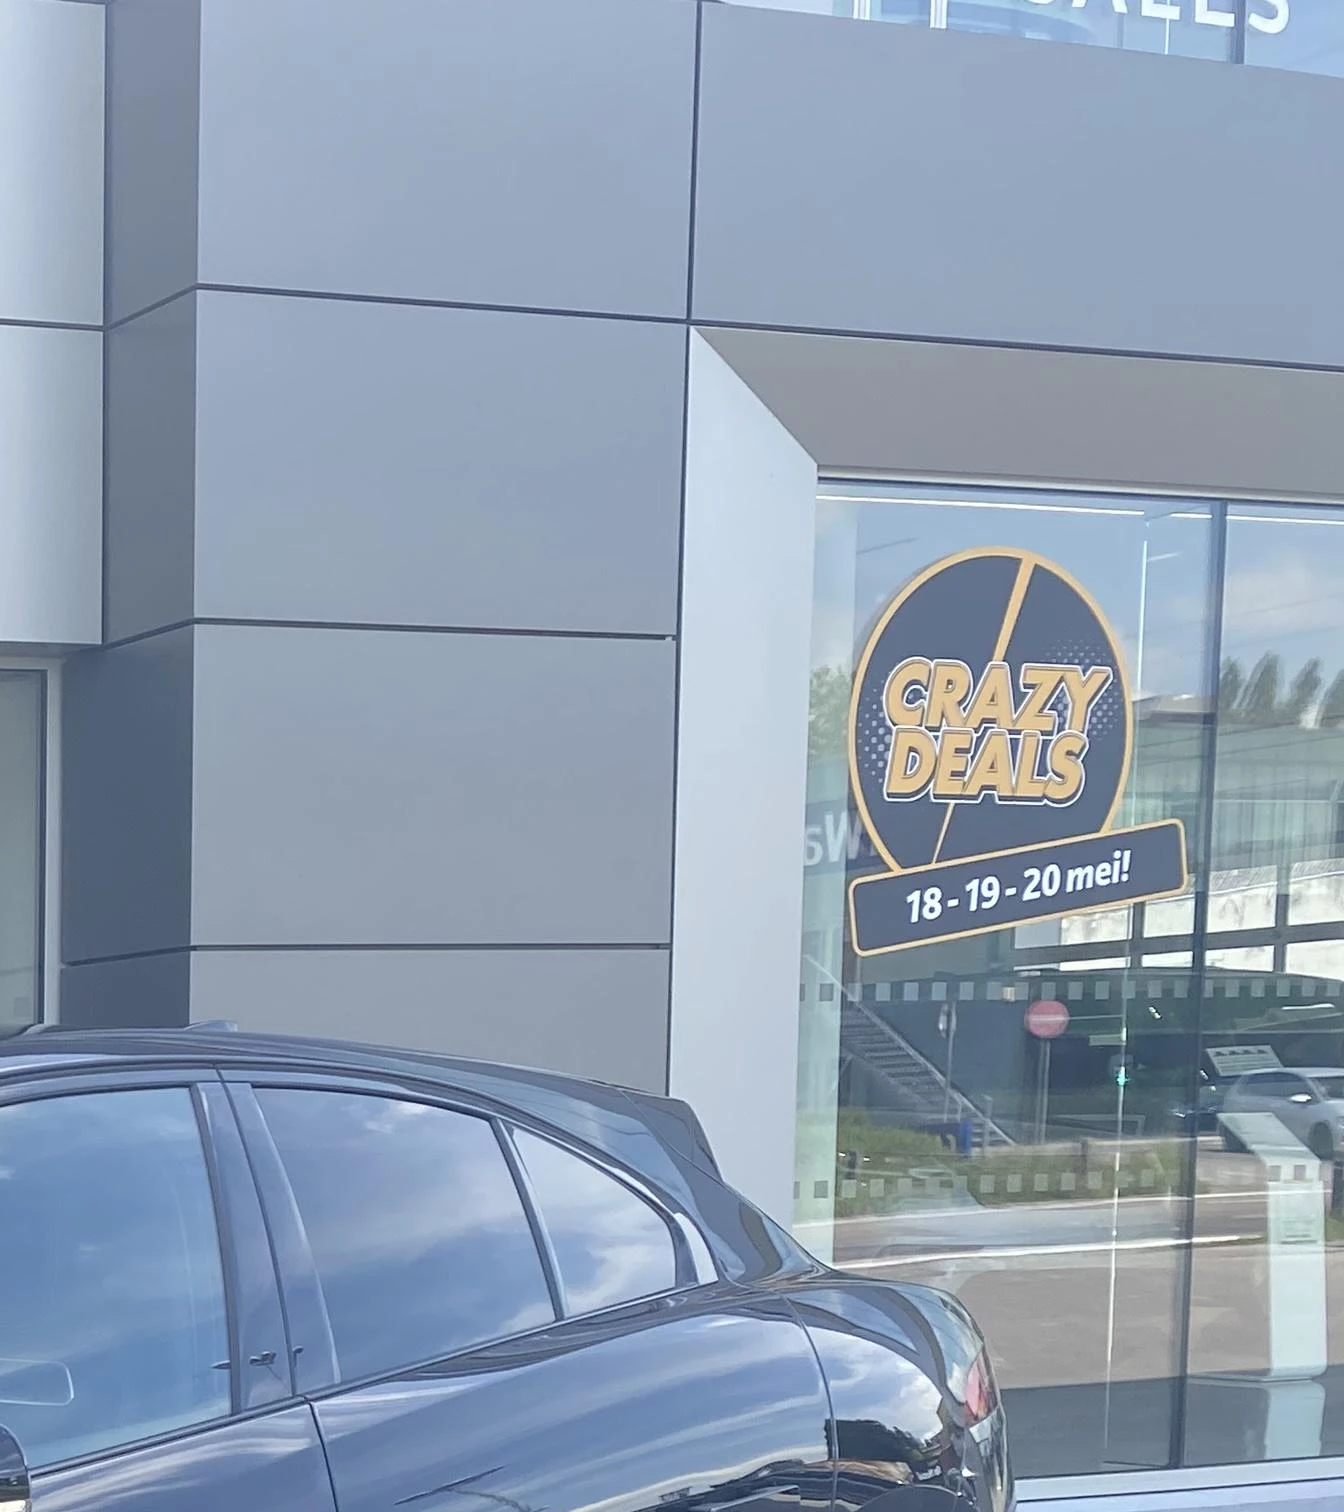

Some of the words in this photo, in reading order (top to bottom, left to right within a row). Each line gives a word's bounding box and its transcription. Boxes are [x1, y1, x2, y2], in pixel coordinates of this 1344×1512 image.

[884, 657, 1113, 737] CRAZY
[883, 727, 1089, 807] DEALS
[905, 885, 943, 923] 18
[964, 875, 1001, 912] 19
[1023, 865, 1061, 901] 20
[1065, 850, 1131, 895] mei!
